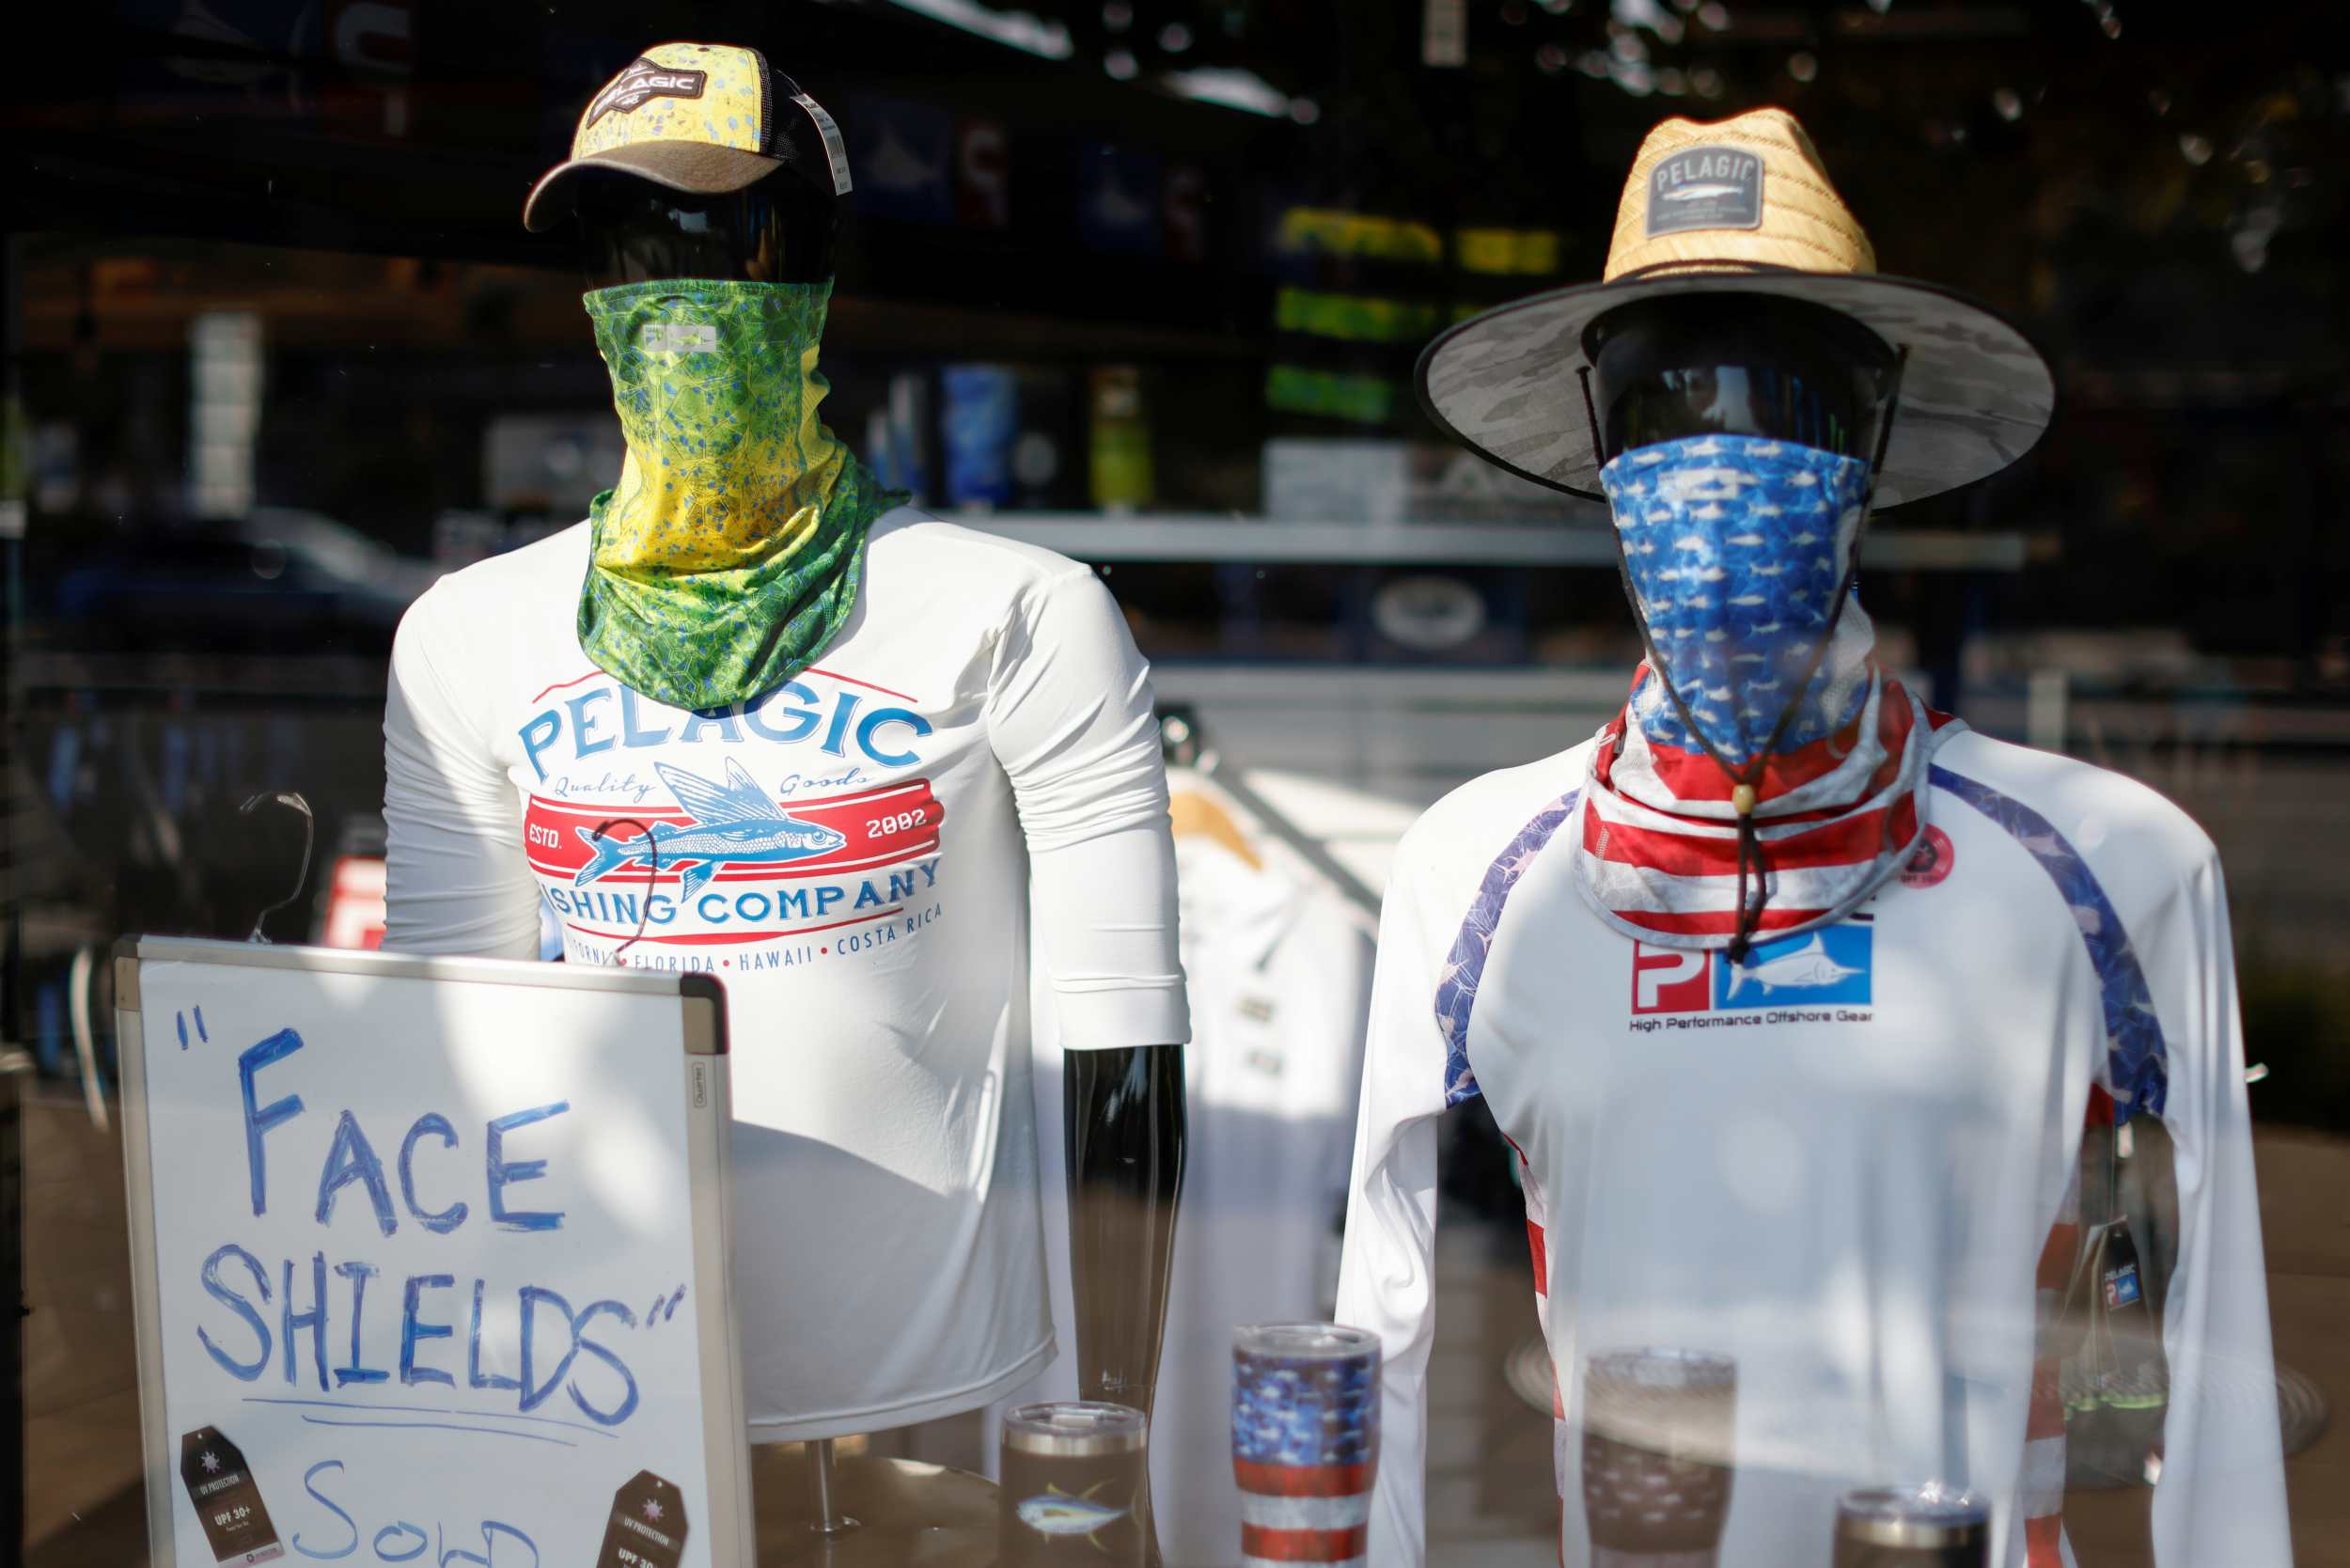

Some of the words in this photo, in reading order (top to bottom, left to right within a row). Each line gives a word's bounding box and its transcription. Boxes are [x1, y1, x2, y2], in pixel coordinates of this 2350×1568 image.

[1656, 154, 1756, 192] PELAGIC
[518, 681, 933, 786] PELAGIC
[555, 773, 655, 804] Quality
[779, 767, 870, 795] Goods
[529, 823, 562, 849] ESTD.
[866, 808, 927, 839] 2002
[541, 882, 678, 925] ISHING
[697, 857, 942, 925] COMPANY
[634, 953, 715, 972] FLORIDA
[740, 946, 812, 971] HAWAII
[838, 920, 896, 956] COSTA
[906, 902, 942, 933] RICA
[1629, 1017, 1662, 1033] High
[1666, 1013, 1762, 1030] Performance
[1766, 1010, 1831, 1024] Offshore
[1836, 1009, 1873, 1023] Gear
[209, 1474, 240, 1492] PROTECTION
[214, 1510, 232, 1527] UPF
[233, 1505, 252, 1520] 30+
[634, 1521, 668, 1546] PROTECTION
[619, 1546, 638, 1564] UPF
